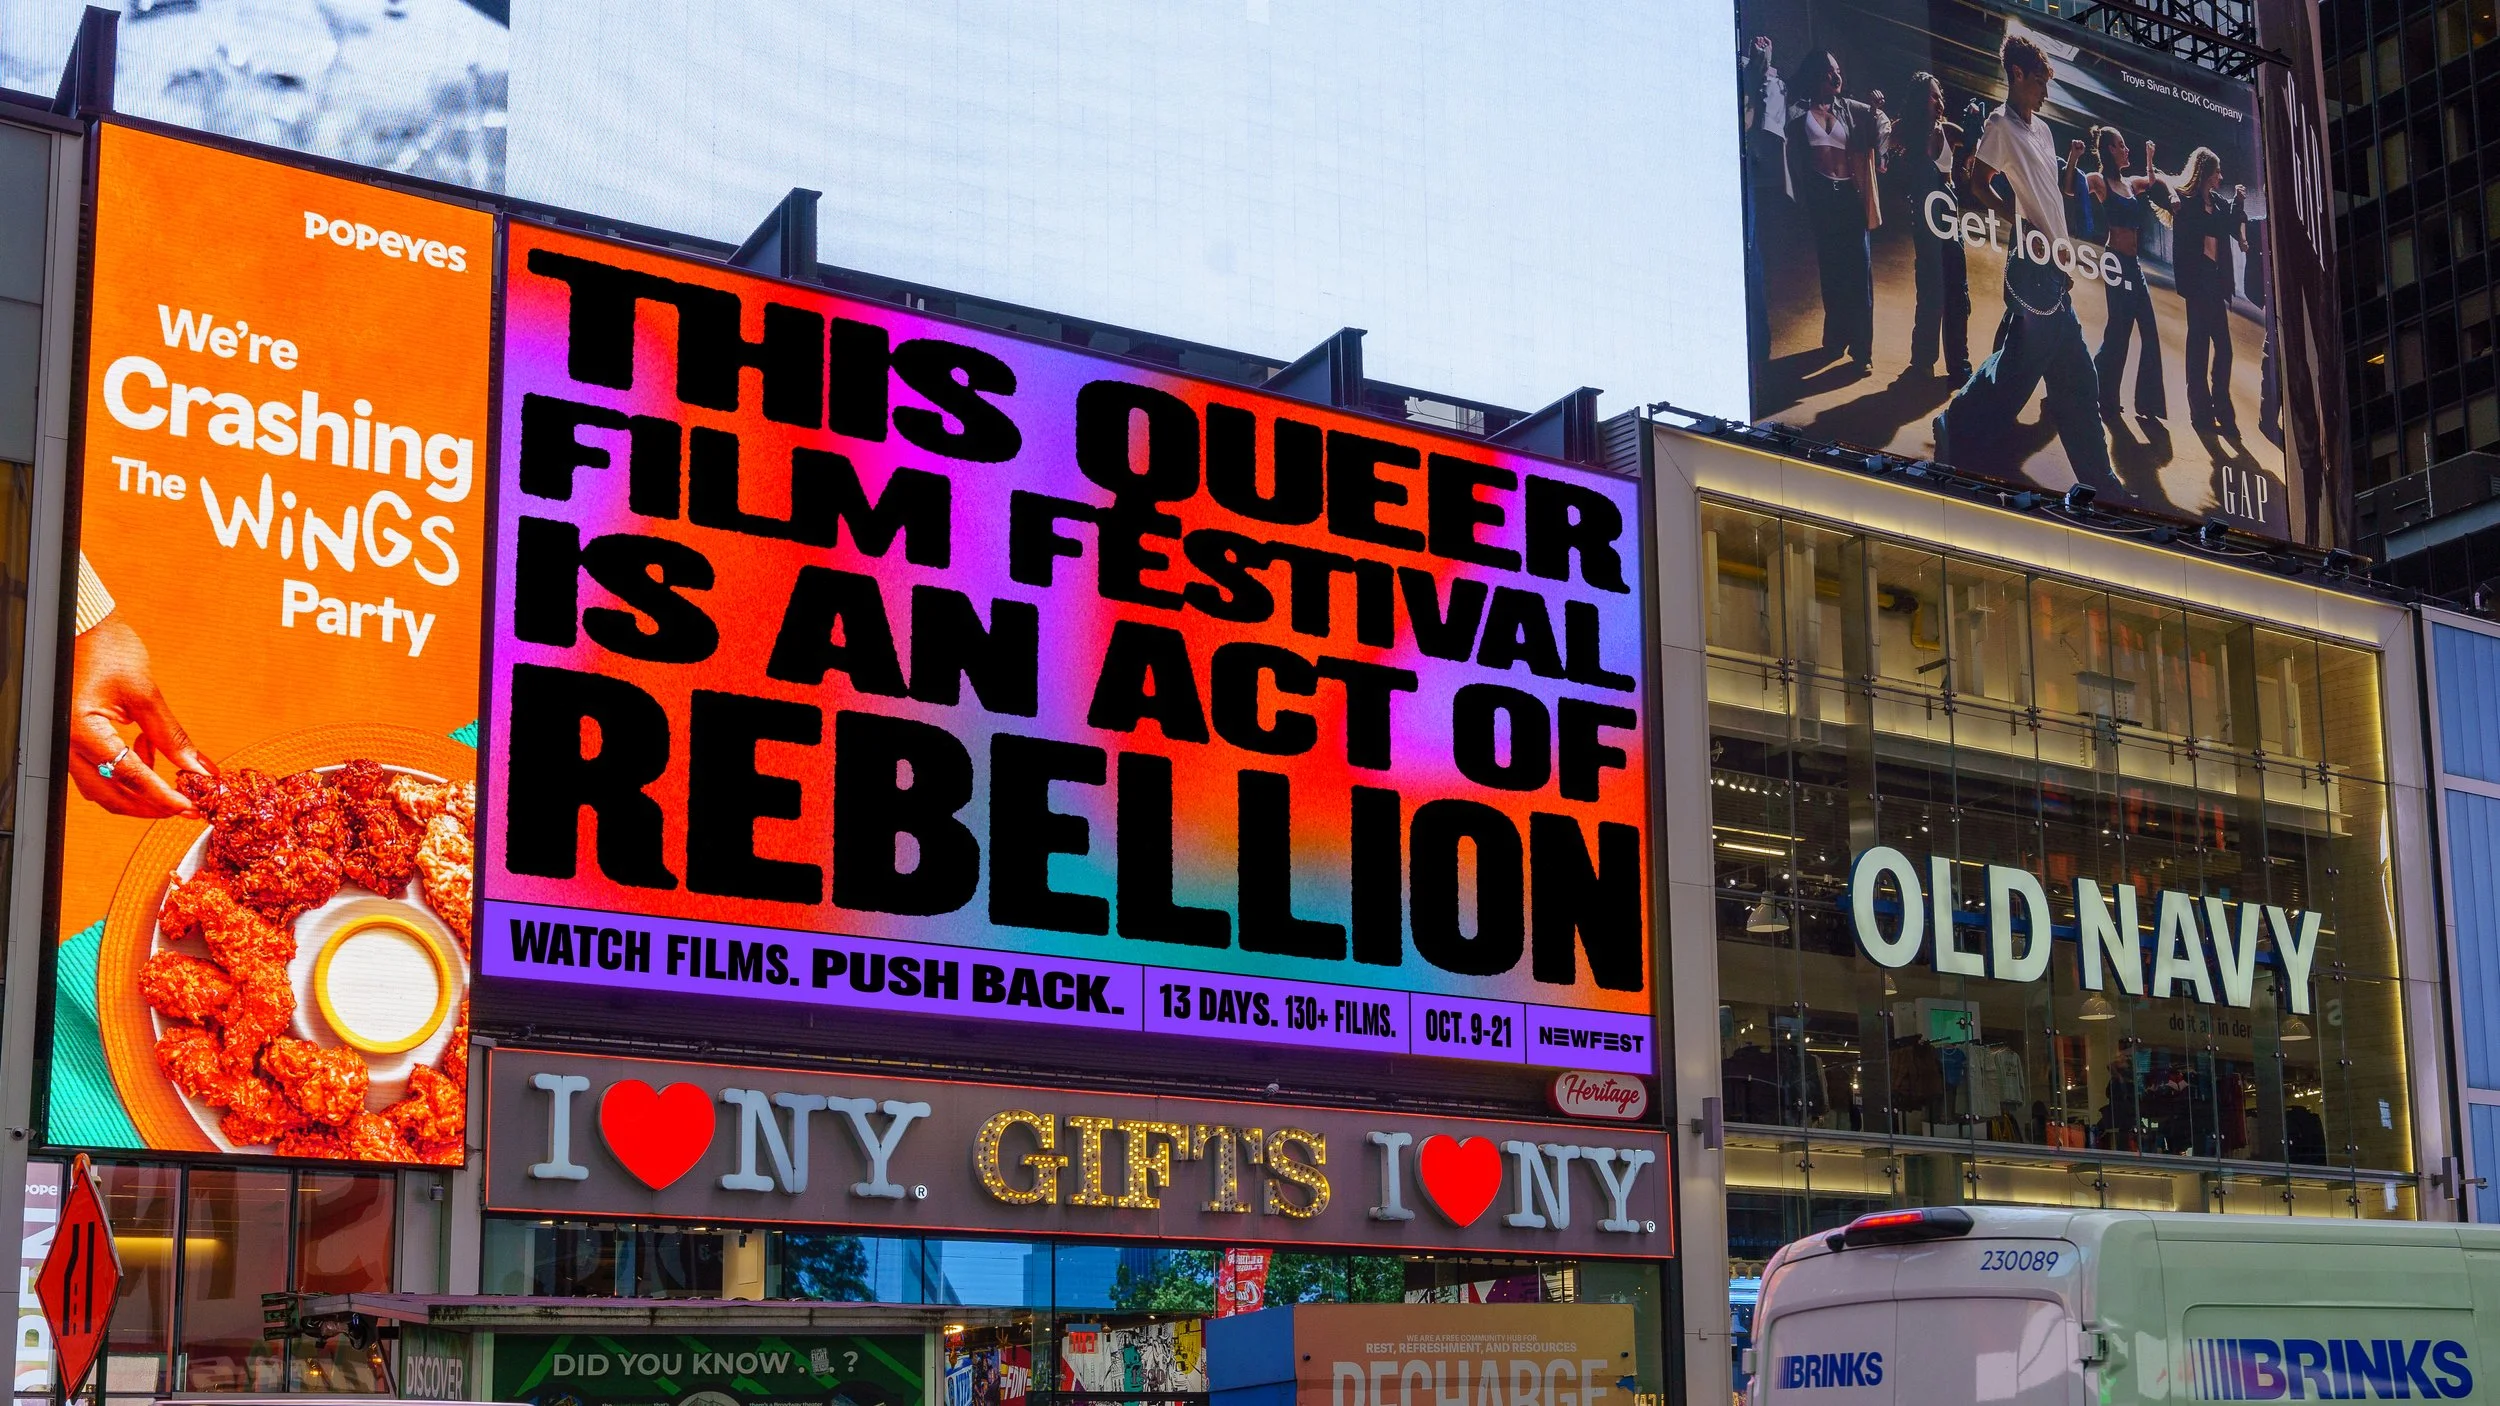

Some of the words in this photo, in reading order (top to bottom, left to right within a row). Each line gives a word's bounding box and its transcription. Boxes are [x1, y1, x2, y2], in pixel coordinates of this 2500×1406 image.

[2120, 70, 2145, 89] Troye
[2146, 78, 2171, 96] Sivan
[2172, 86, 2180, 99] &
[2180, 89, 2201, 107] CDK
[2202, 98, 2243, 123] Company
[1923, 189, 2004, 254] Get
[2014, 212, 2133, 292] loose.
[102, 354, 475, 503] Crashing
[527, 247, 1023, 464] THIS
[1075, 378, 1631, 596] QUEER
[111, 455, 187, 502] The
[2221, 464, 2269, 524] GAP
[518, 391, 953, 570] FILM
[1009, 489, 1637, 694] FESTIVAL
[281, 577, 437, 658] Party
[514, 514, 720, 665] IS
[765, 564, 1040, 718] AN
[1087, 619, 1419, 772] ACT
[1453, 682, 1638, 803] OF
[505, 661, 1645, 993] REBELLION
[1848, 844, 2054, 984] OLD
[2073, 876, 2323, 1016] NAVY
[509, 918, 651, 974] WATCH
[666, 933, 800, 988] FILMS.
[811, 947, 960, 1001] PUSH
[971, 962, 1125, 1017] BACK.
[1158, 983, 1192, 1019] 13
[1199, 987, 1279, 1028] DAYS.
[1285, 996, 1329, 1031] 130+
[1334, 999, 1397, 1039] FILMS.
[1424, 1008, 1467, 1046] OCT.
[1470, 1012, 1513, 1048] 9-21
[2169, 1013, 2184, 1031] do
[2218, 1018, 2229, 1035] in
[1538, 1025, 1644, 1055] NEWFEST
[1564, 1074, 1640, 1115] Heritage
[528, 1072, 591, 1182] I
[972, 1108, 1331, 1220] GIFTS
[1365, 1130, 1416, 1223] I
[1979, 1249, 2060, 1272] 230089
[553, 1353, 610, 1376] DID
[617, 1353, 682, 1376] YOU
[692, 1351, 791, 1375] KNOW
[1366, 1342, 1397, 1355] REST,
[1398, 1342, 1484, 1354] REFRESHMENT,
[1485, 1342, 1510, 1353] AND
[1512, 1342, 1577, 1353] RESOURCES
[1406, 1334, 1418, 1342] WE
[1419, 1334, 1434, 1342] ARE
[1435, 1334, 1441, 1342] A
[1443, 1334, 1460, 1342] FREE
[1460, 1334, 1506, 1343] COMMUNITY
[1507, 1334, 1522, 1342] HUB
[1523, 1334, 1538, 1342] FOR
[406, 1355, 464, 1400] DISCOVER
[1004, 1365, 1028, 1400] FDNY
[1788, 1351, 1883, 1390] BRINKS
[2237, 1338, 2474, 1401] BRINKS
